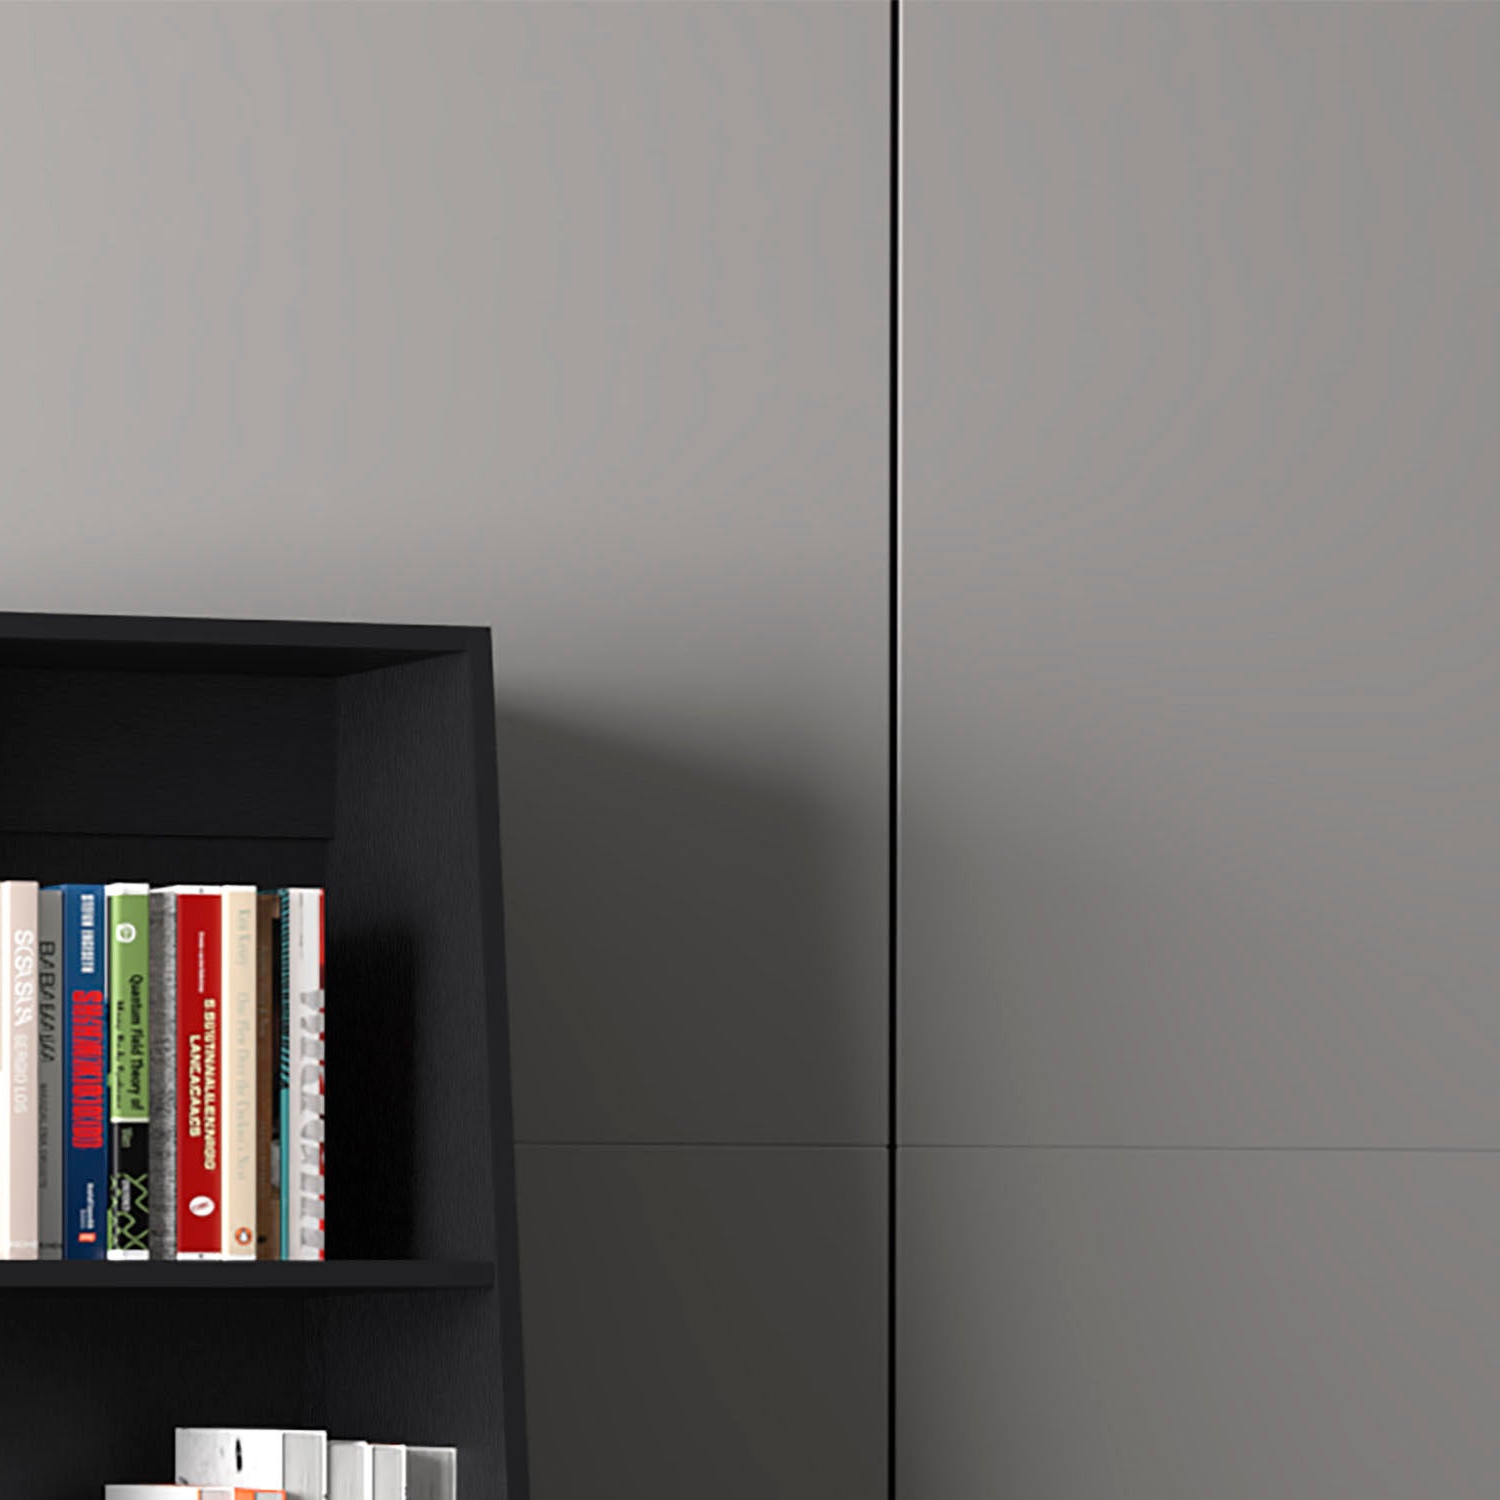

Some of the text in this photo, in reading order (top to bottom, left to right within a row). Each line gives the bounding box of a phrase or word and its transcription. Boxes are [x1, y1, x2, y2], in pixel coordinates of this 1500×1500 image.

[127, 974, 145, 1111] Quantum Field Theory of
[14, 1087, 29, 1114] LOS
